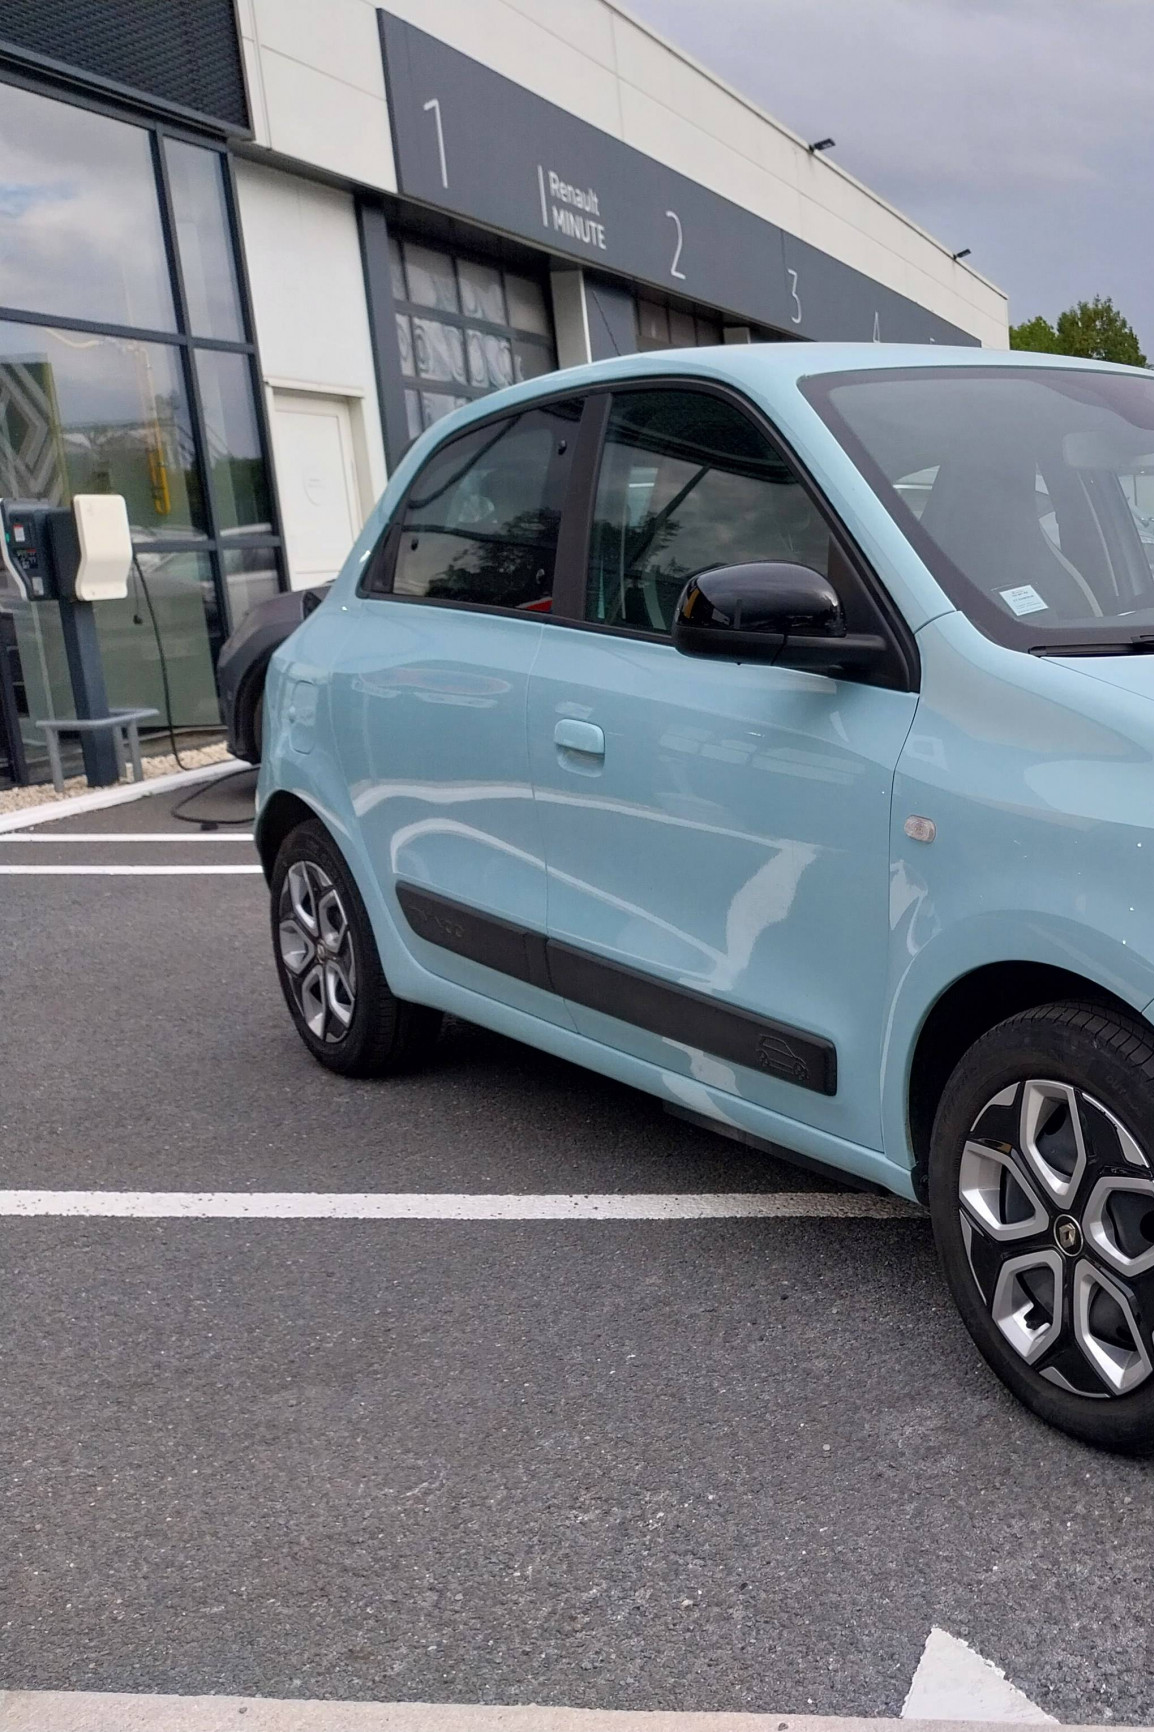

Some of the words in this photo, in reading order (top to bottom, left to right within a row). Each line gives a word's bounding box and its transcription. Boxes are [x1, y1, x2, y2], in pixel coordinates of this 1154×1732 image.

[422, 97, 449, 189] 1
[549, 171, 600, 216] Renault
[553, 208, 606, 250] MINUTE
[665, 210, 687, 280] 2
[786, 268, 803, 324] 3
